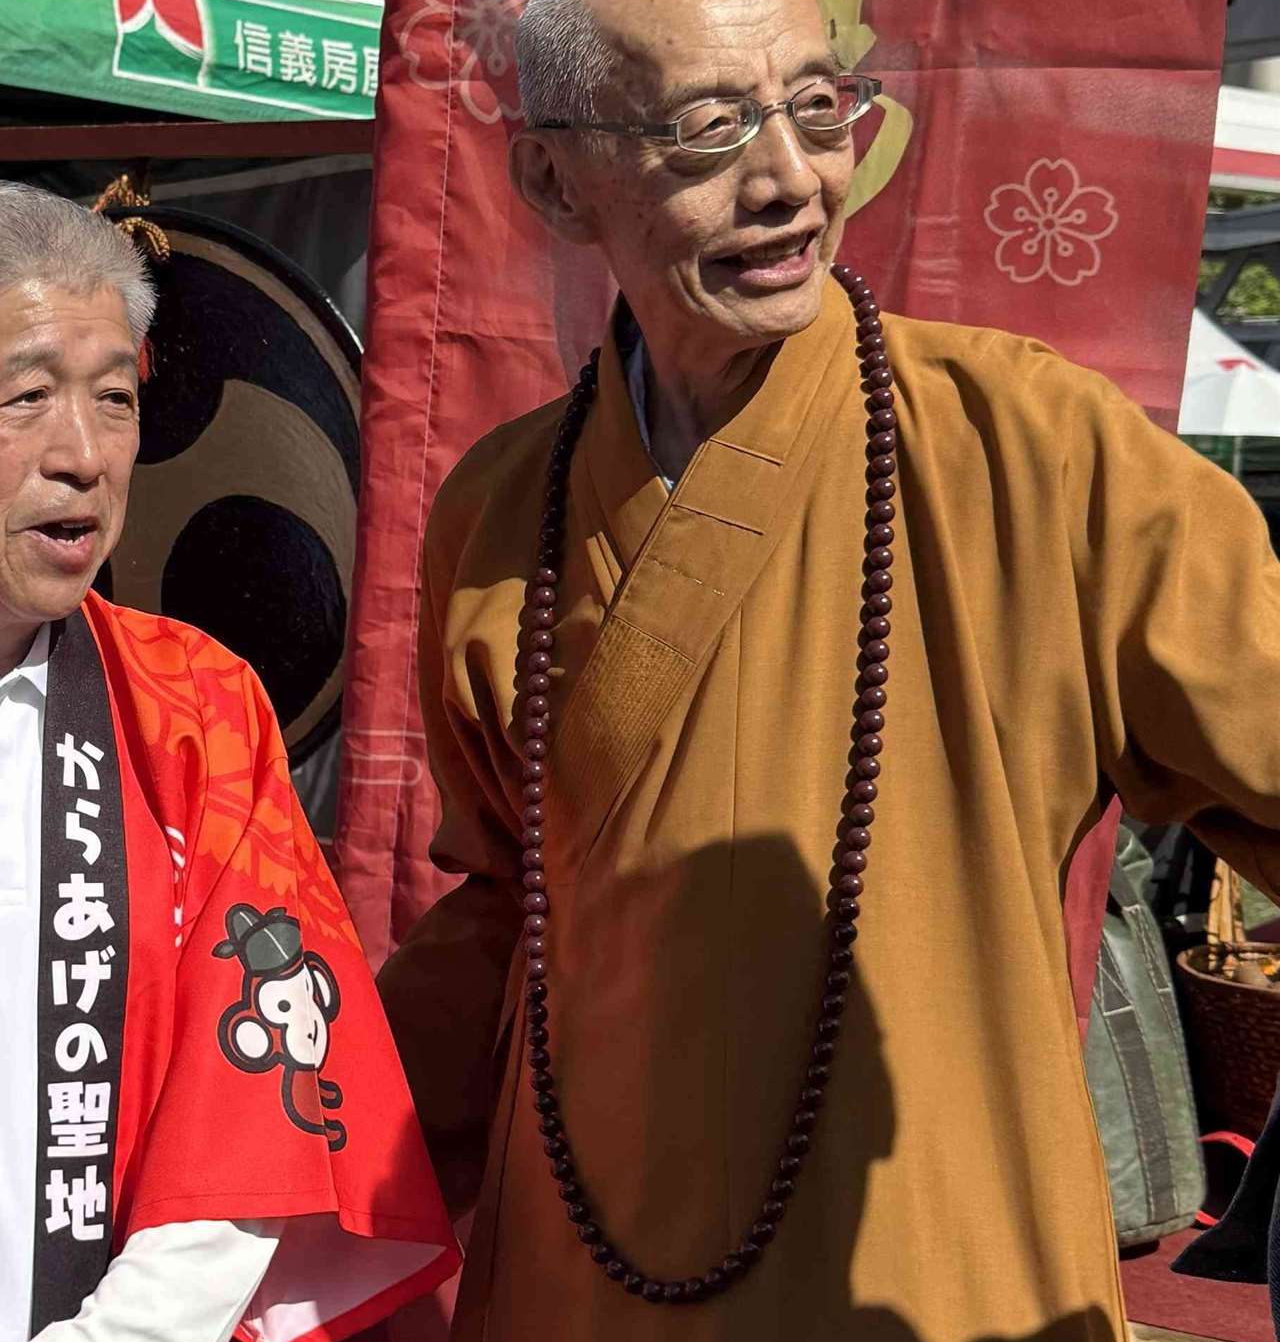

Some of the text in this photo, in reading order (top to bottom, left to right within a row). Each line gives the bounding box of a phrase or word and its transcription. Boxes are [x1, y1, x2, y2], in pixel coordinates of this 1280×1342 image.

[45, 732, 118, 1243] からあげの聖地
